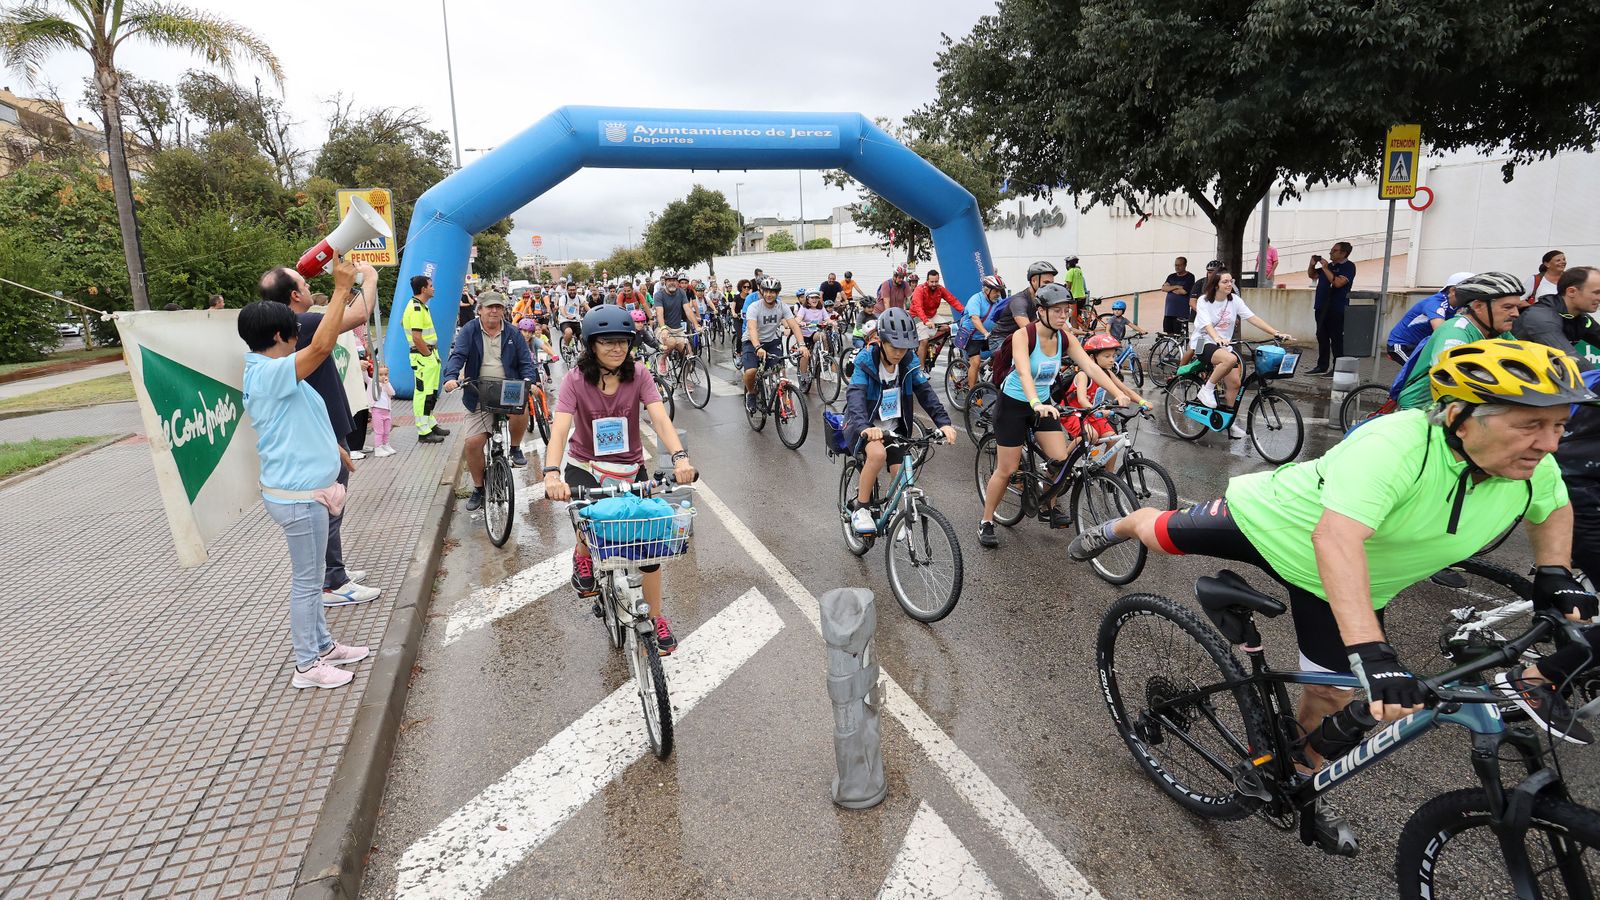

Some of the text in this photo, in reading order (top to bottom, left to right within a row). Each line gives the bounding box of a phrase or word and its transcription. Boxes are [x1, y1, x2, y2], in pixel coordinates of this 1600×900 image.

[633, 125, 833, 138] Ayuntamiento de Jerez
[633, 135, 694, 144] Deportes
[1386, 185, 1412, 195] PEATONES
[351, 252, 391, 264] PEATONES
[763, 314, 778, 325] HH
[171, 408, 207, 447] Corte
[198, 391, 236, 445] Inglés
